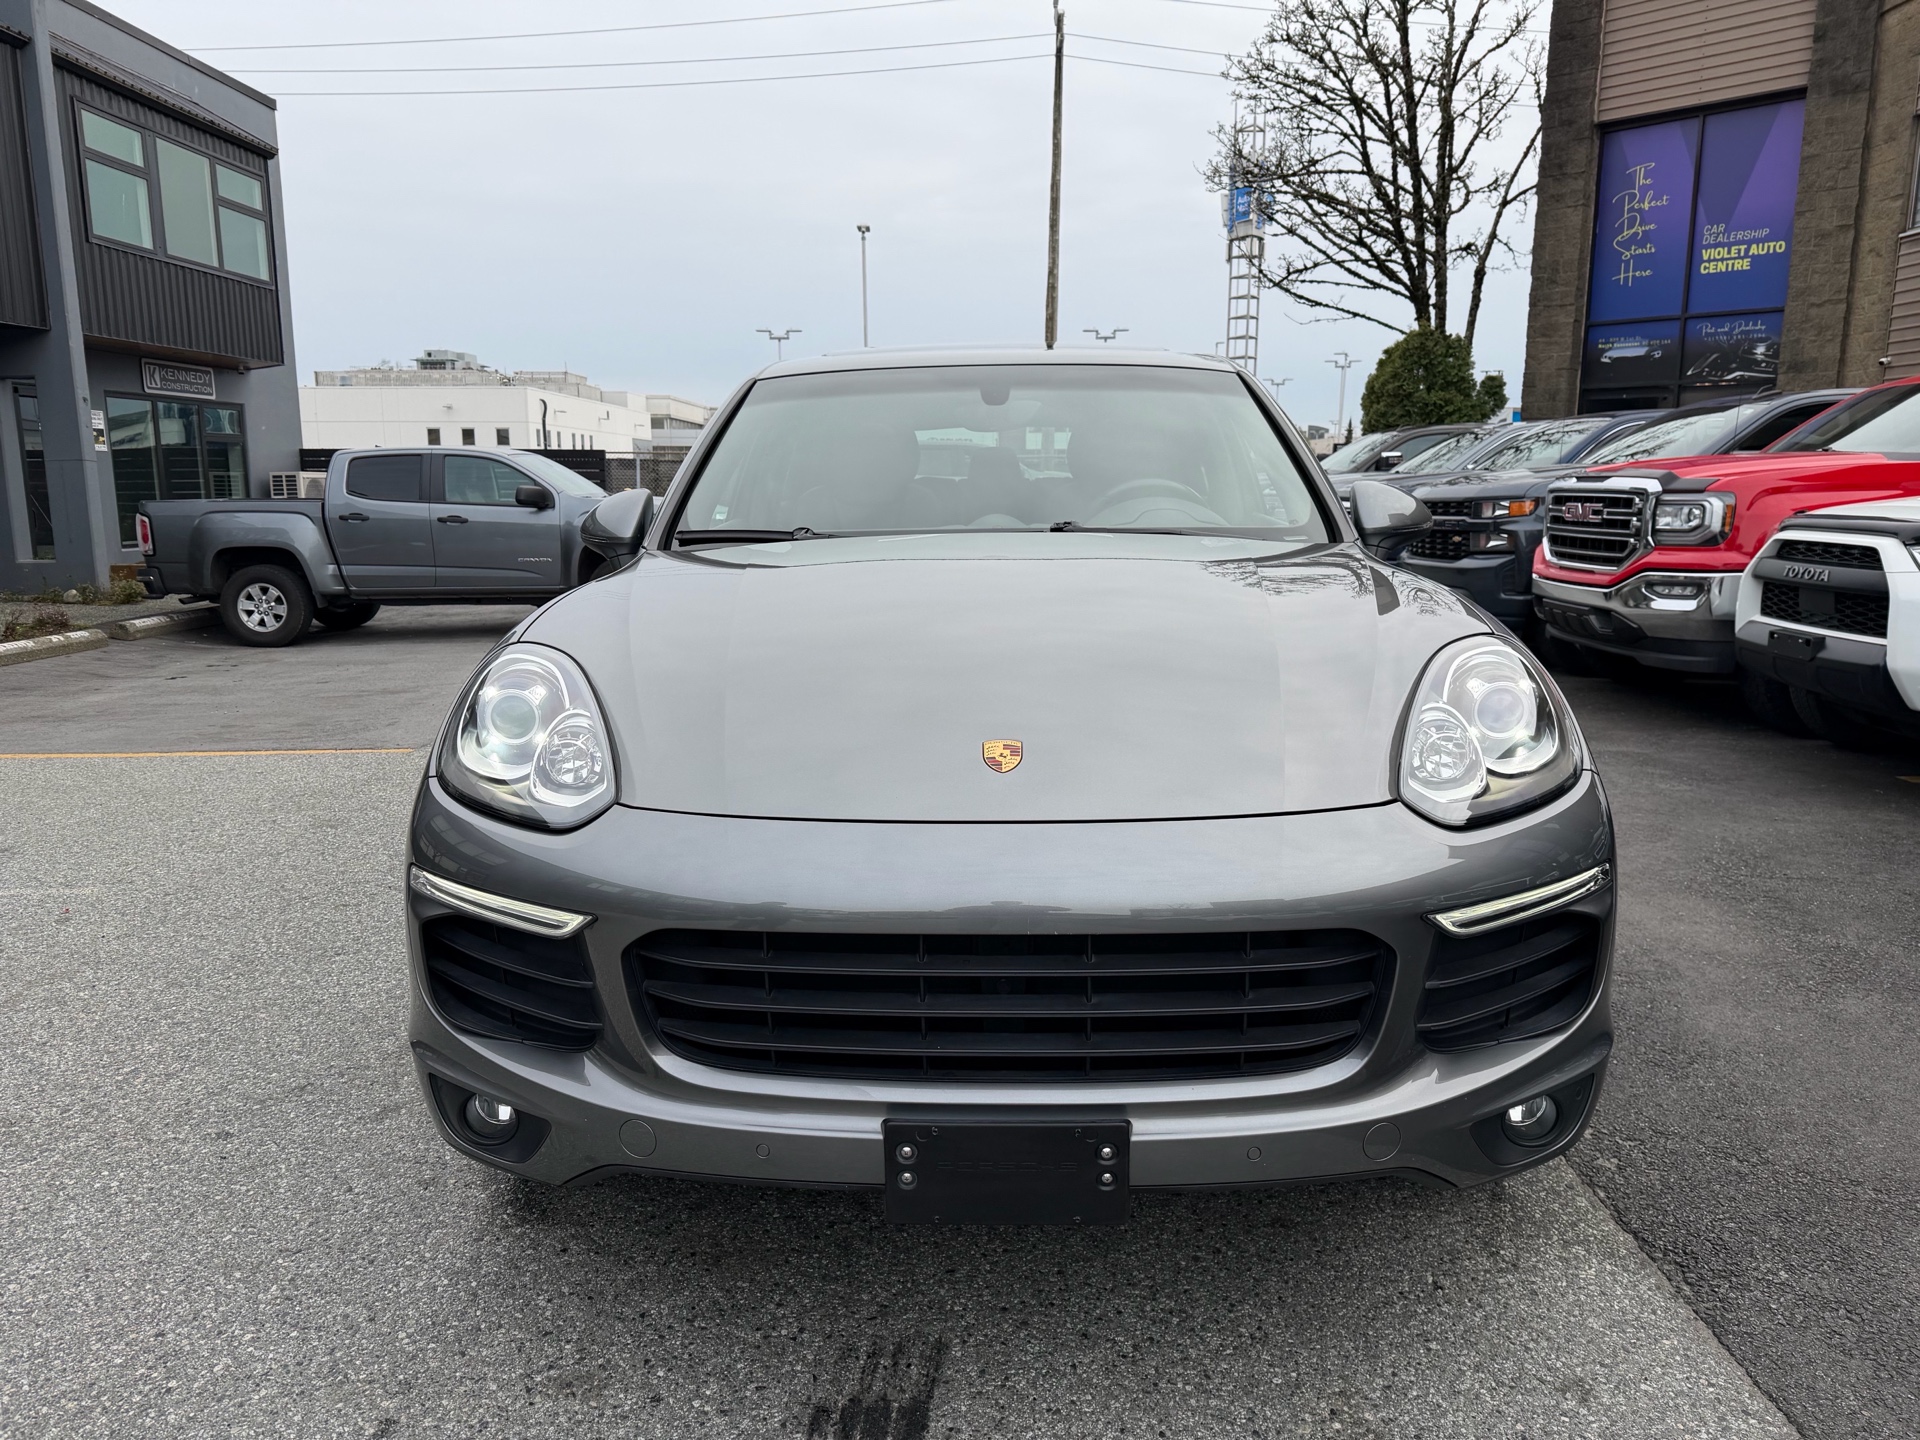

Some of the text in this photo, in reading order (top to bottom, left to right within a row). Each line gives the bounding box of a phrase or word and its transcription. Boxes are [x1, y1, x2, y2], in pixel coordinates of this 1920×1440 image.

[1626, 162, 1655, 193] The
[1612, 190, 1670, 218] Perfect
[1615, 212, 1657, 241] Drive
[1702, 228, 1770, 245] DEALERSHIP
[1703, 223, 1726, 235] CAR
[1613, 229, 1656, 260] Starts
[1702, 240, 1786, 261] VIOLET AUTO
[1612, 259, 1653, 287] Here
[1700, 258, 1751, 275] CENTRE
[160, 367, 211, 384] KENNEDY
[161, 381, 213, 394] CONSTRUCTION
[1564, 502, 1603, 522] GMC
[1783, 565, 1830, 582] TOYOTA
